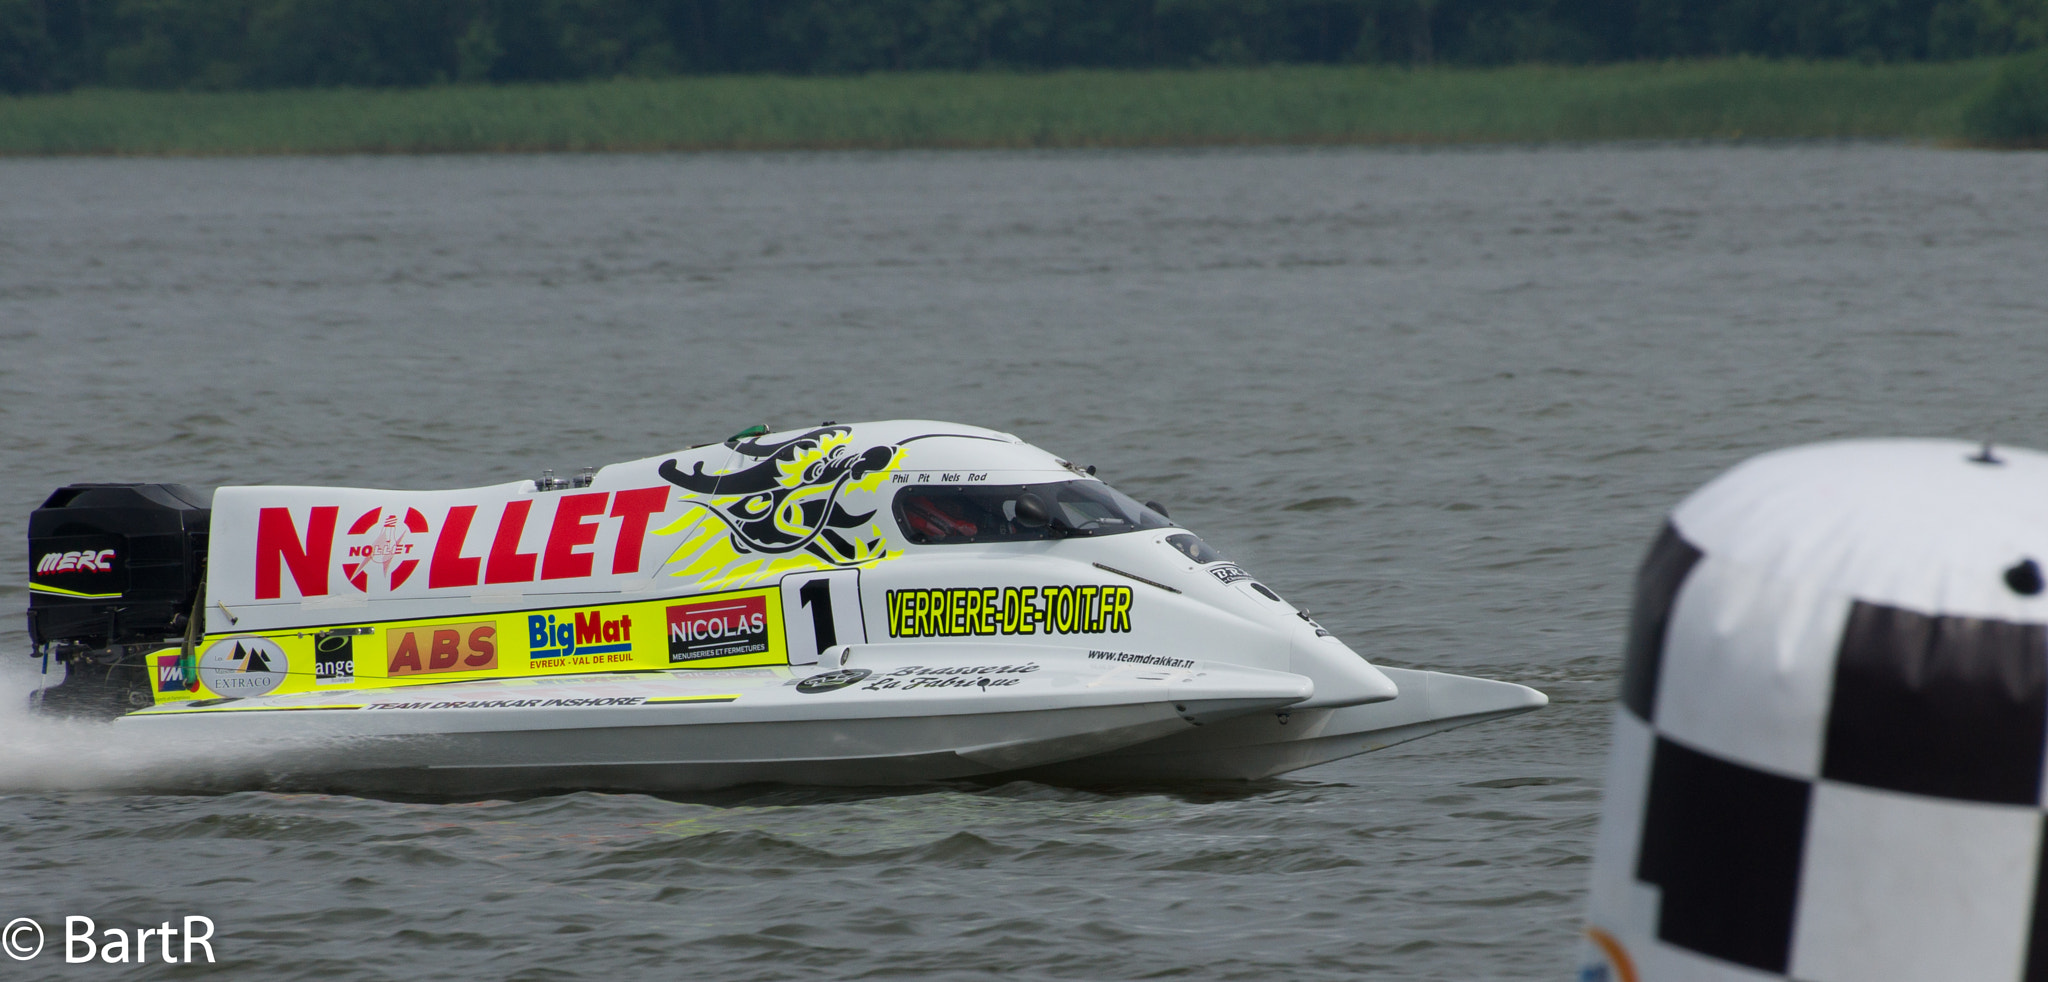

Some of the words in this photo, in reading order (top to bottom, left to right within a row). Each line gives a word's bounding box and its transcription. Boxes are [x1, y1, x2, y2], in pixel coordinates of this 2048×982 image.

[892, 474, 909, 483] Phil
[918, 473, 930, 482] Pit
[968, 473, 987, 481] Rod
[255, 485, 670, 600] NOLLET
[349, 543, 414, 557] NOLLET
[37, 549, 116, 576] MERC
[800, 578, 837, 655] 1
[886, 586, 1132, 638] VERRIERE-DE-TOIT.FR
[528, 611, 632, 656] BigMat
[671, 613, 764, 643] NICOLAS
[388, 626, 496, 672] ABS
[672, 649, 715, 661] MENUISERIES
[715, 648, 723, 656] ET
[724, 644, 765, 655] FERMETURES
[316, 660, 354, 678] ange
[530, 659, 566, 669] EVREUX
[573, 657, 590, 665] VAL
[593, 655, 604, 664] DE
[607, 653, 633, 663] REUIL
[886, 662, 1040, 676] Brasserie
[215, 677, 271, 689] EXTRACO
[862, 677, 901, 691] La
[368, 701, 432, 710] TEAM
[429, 699, 542, 710] DRAKKAR
[541, 696, 645, 707] INSHORE
